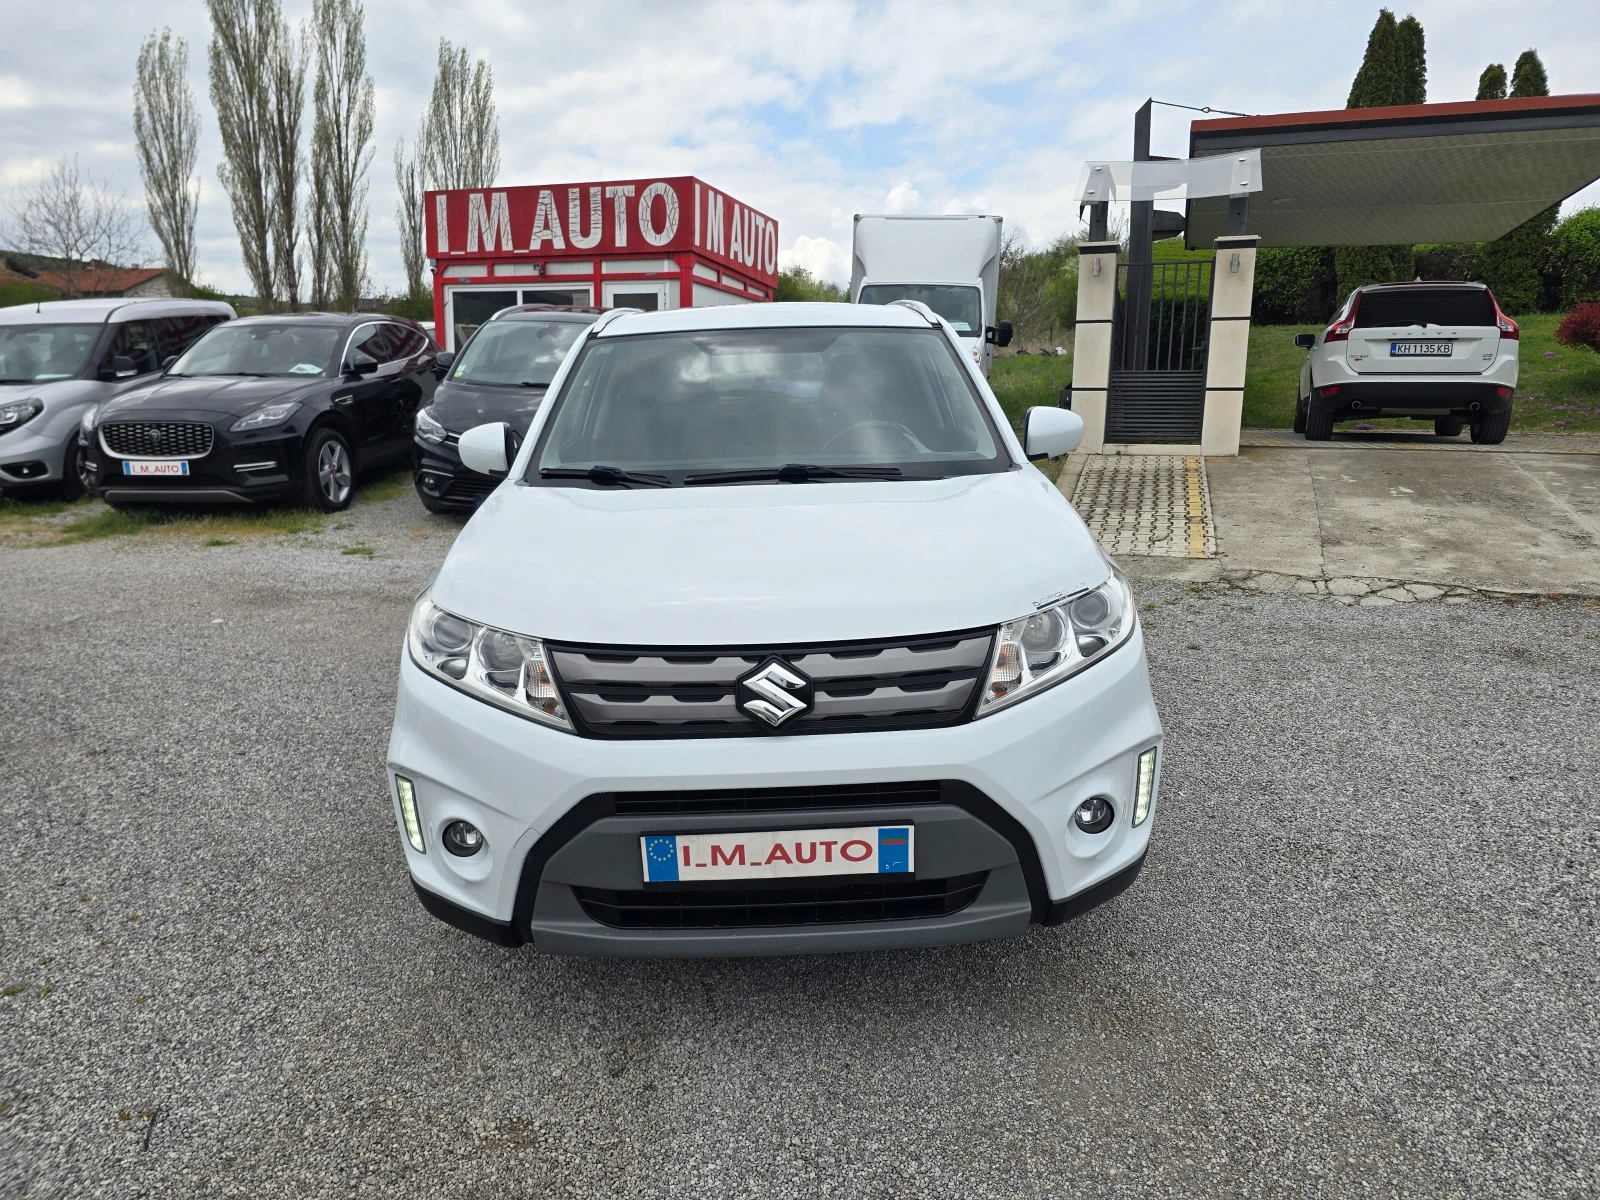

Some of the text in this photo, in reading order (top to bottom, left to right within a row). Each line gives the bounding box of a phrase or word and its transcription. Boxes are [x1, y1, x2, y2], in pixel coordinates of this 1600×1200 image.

[706, 189, 724, 256] M
[729, 203, 776, 275] AUTO
[1413, 344, 1436, 353] 1135
[1436, 344, 1450, 353] KB
